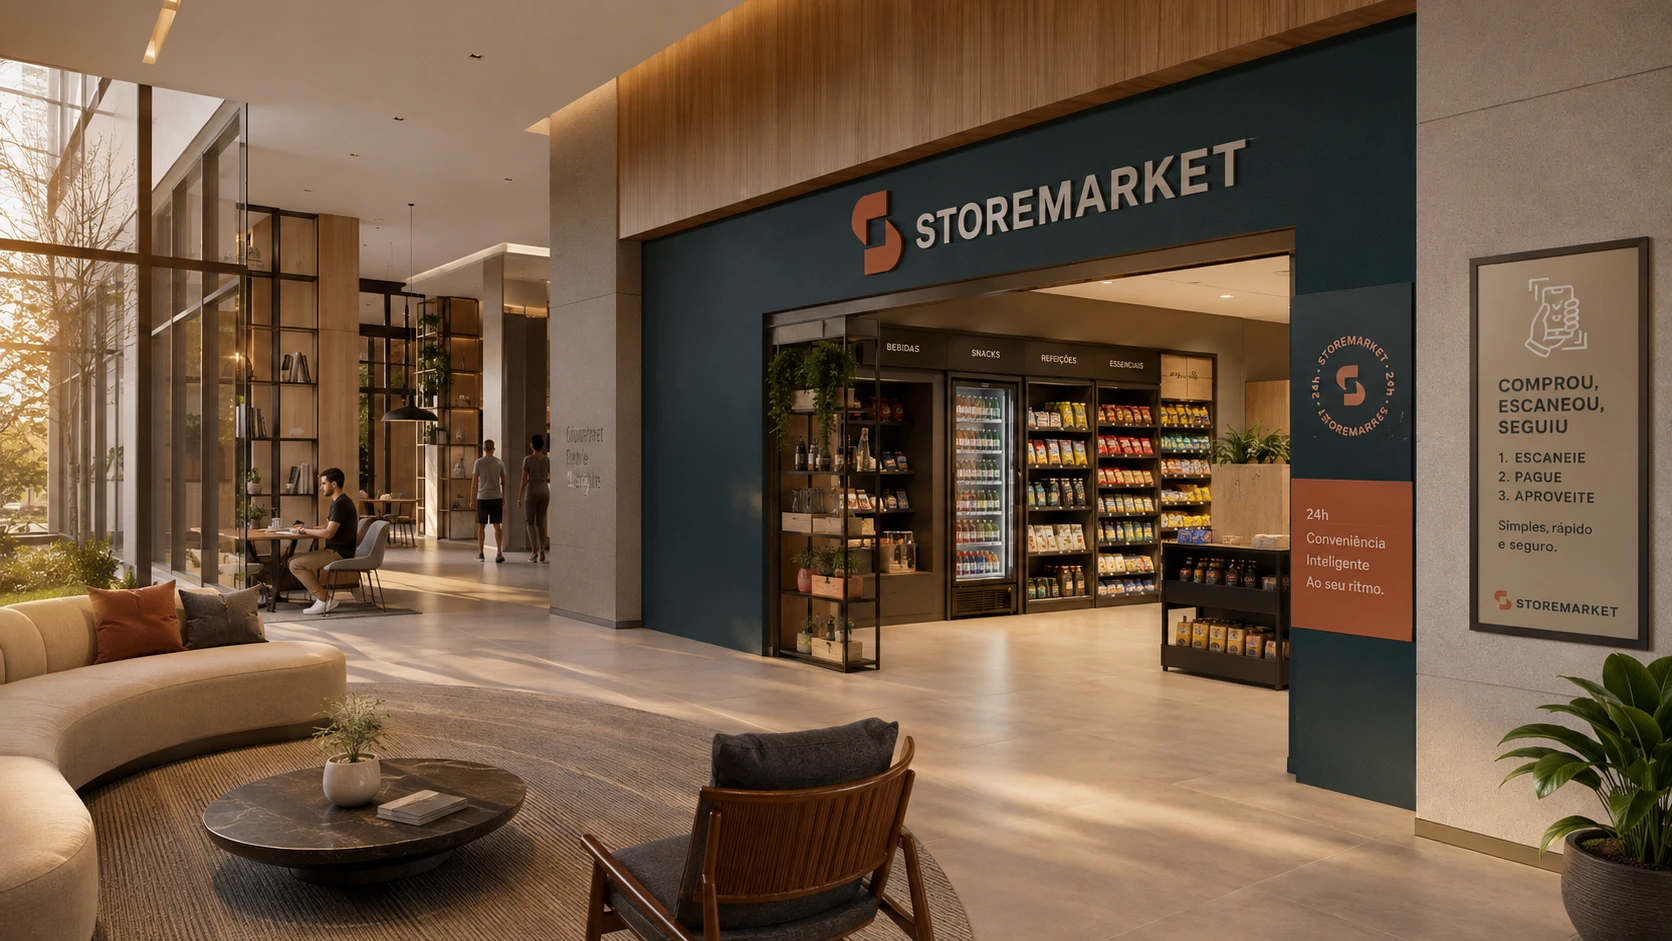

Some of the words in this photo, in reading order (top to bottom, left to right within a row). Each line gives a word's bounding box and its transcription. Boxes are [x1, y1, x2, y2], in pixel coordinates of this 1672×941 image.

[915, 138, 1247, 249] STOREMARKET
[886, 342, 920, 353] BEBIDAS
[971, 349, 1001, 359] SNACKS
[1317, 335, 1389, 366] STOREMARKET
[1498, 375, 1599, 392] COMPROU,
[1498, 396, 1604, 413] ESCANEOU,
[1498, 419, 1568, 434] SEGUIU
[1498, 452, 1508, 463] 1.
[1515, 452, 1586, 464] ESCANEIE
[1498, 471, 1510, 482] 2.
[1515, 471, 1562, 483] PAGUE
[1498, 490, 1510, 501] 3.
[1514, 490, 1595, 503] APROVEITE
[1306, 508, 1329, 520] 24h
[1498, 520, 1549, 534] Simples,
[1552, 522, 1593, 536] rápido
[1306, 532, 1386, 549] Conveniência
[1498, 540, 1506, 549] e
[1509, 541, 1557, 553] seguro.
[1306, 554, 1370, 571] Inteligente
[1306, 576, 1322, 588] Ao
[1324, 580, 1345, 591] seu
[1348, 580, 1384, 595] ritmo.
[1516, 599, 1618, 617] STOREMARKET
